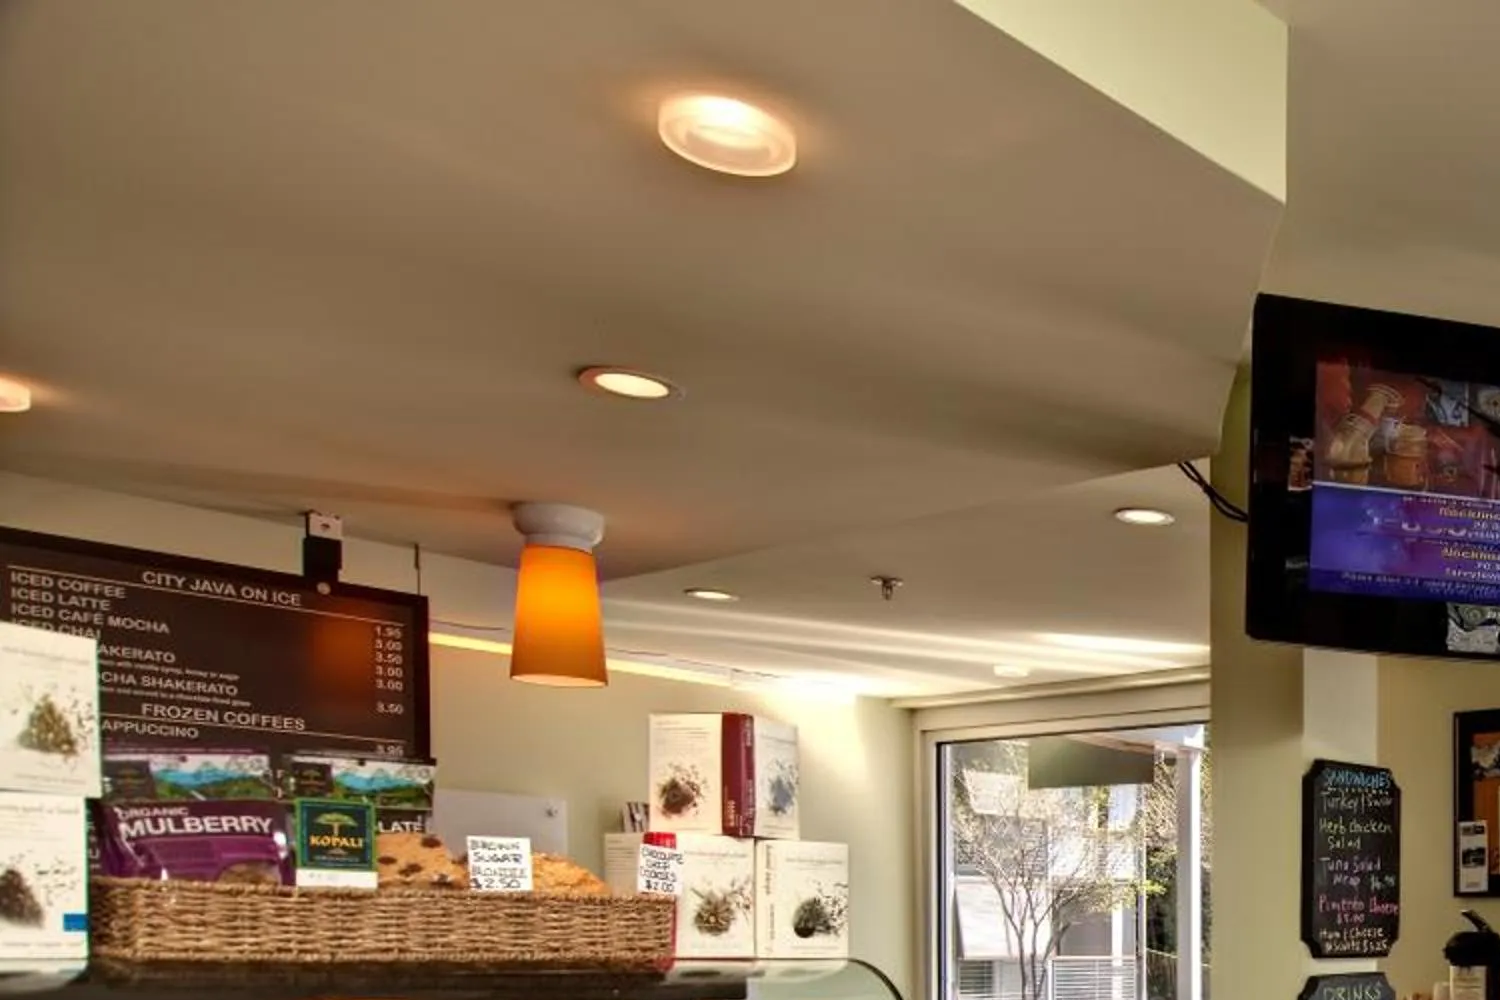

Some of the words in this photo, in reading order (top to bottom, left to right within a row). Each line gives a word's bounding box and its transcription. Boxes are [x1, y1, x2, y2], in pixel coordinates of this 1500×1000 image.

[11, 571, 53, 588] ICED
[58, 578, 126, 599] COFFEE
[142, 571, 186, 588] CITY
[190, 579, 236, 596] JAVA
[241, 586, 268, 601] ON
[272, 591, 301, 606] ICE
[11, 587, 53, 603] ICED
[58, 594, 111, 611] LATTE
[11, 603, 54, 618] ICED
[107, 615, 170, 634] MOCHA
[97, 644, 176, 664] AKERATO
[99, 671, 137, 685] CHA
[140, 674, 238, 696] SHAKERATO
[141, 703, 219, 722] FROZEN
[223, 711, 305, 731] COFFEES
[101, 720, 199, 739] APPUCCINO
[118, 807, 188, 819] ORGANIC
[118, 816, 272, 837] MULBERRY
[310, 835, 363, 848] KOPALI
